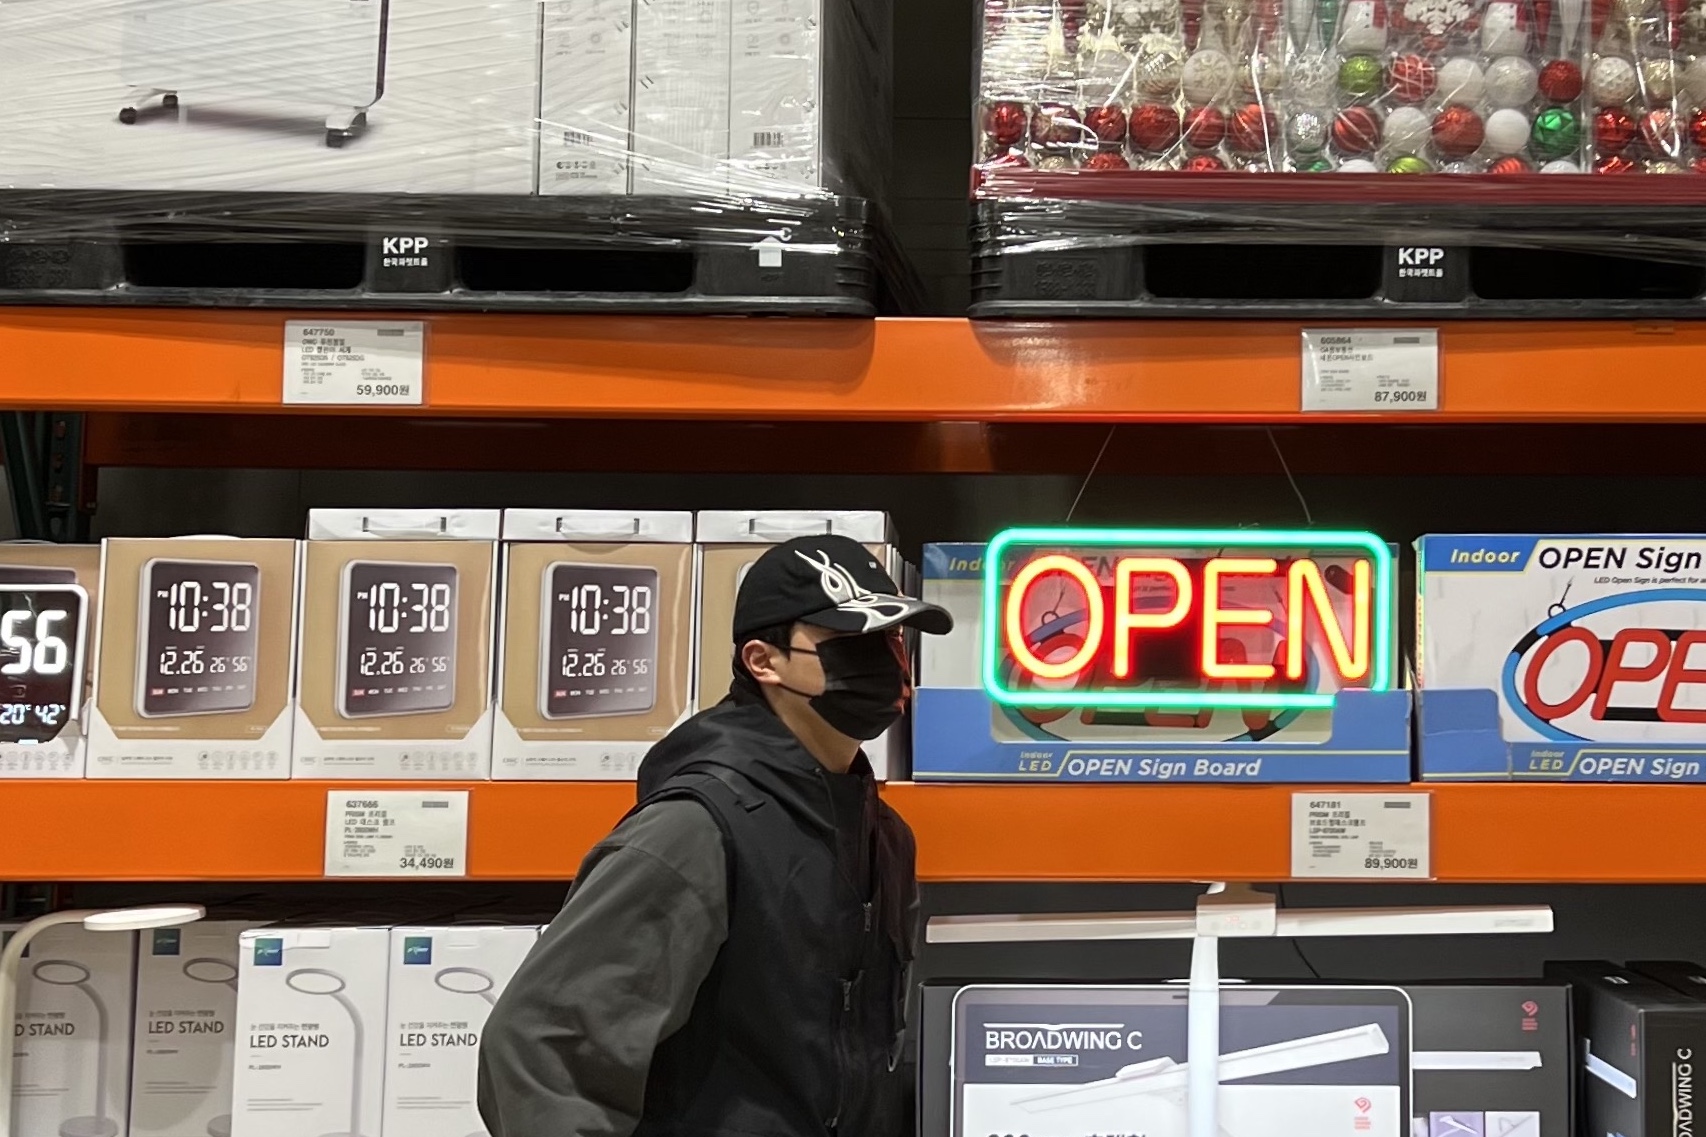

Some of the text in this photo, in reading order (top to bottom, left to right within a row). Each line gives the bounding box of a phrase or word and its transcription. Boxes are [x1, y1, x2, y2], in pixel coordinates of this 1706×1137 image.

[383, 236, 429, 254] KPP
[1399, 247, 1444, 265] KPP
[356, 384, 410, 397] 59,900원
[1374, 391, 1427, 403] 87,900원
[1450, 549, 1520, 564] Indoor
[1538, 546, 1702, 573] OPEN Sign
[168, 581, 252, 632] 10:38
[368, 582, 451, 633] 10:38
[569, 584, 652, 636] 10:38
[1006, 554, 1370, 680] OPEN
[160, 651, 205, 675] 12.26
[360, 651, 405, 677] 12.26
[562, 652, 606, 678] 12.26
[1018, 757, 1262, 780] LED OPEN Sign Board
[1529, 757, 1701, 779] LED OPEN Sign
[400, 857, 455, 871] 34,490원
[1364, 858, 1418, 870] 89,900원
[29, 1022, 75, 1037] STAND
[148, 1020, 224, 1034] LED STAND
[250, 1034, 330, 1048] LED STAND
[400, 1033, 478, 1047] LED STAND
[985, 1030, 1143, 1050] BROADWING C
[1678, 1047, 1693, 1060] C
